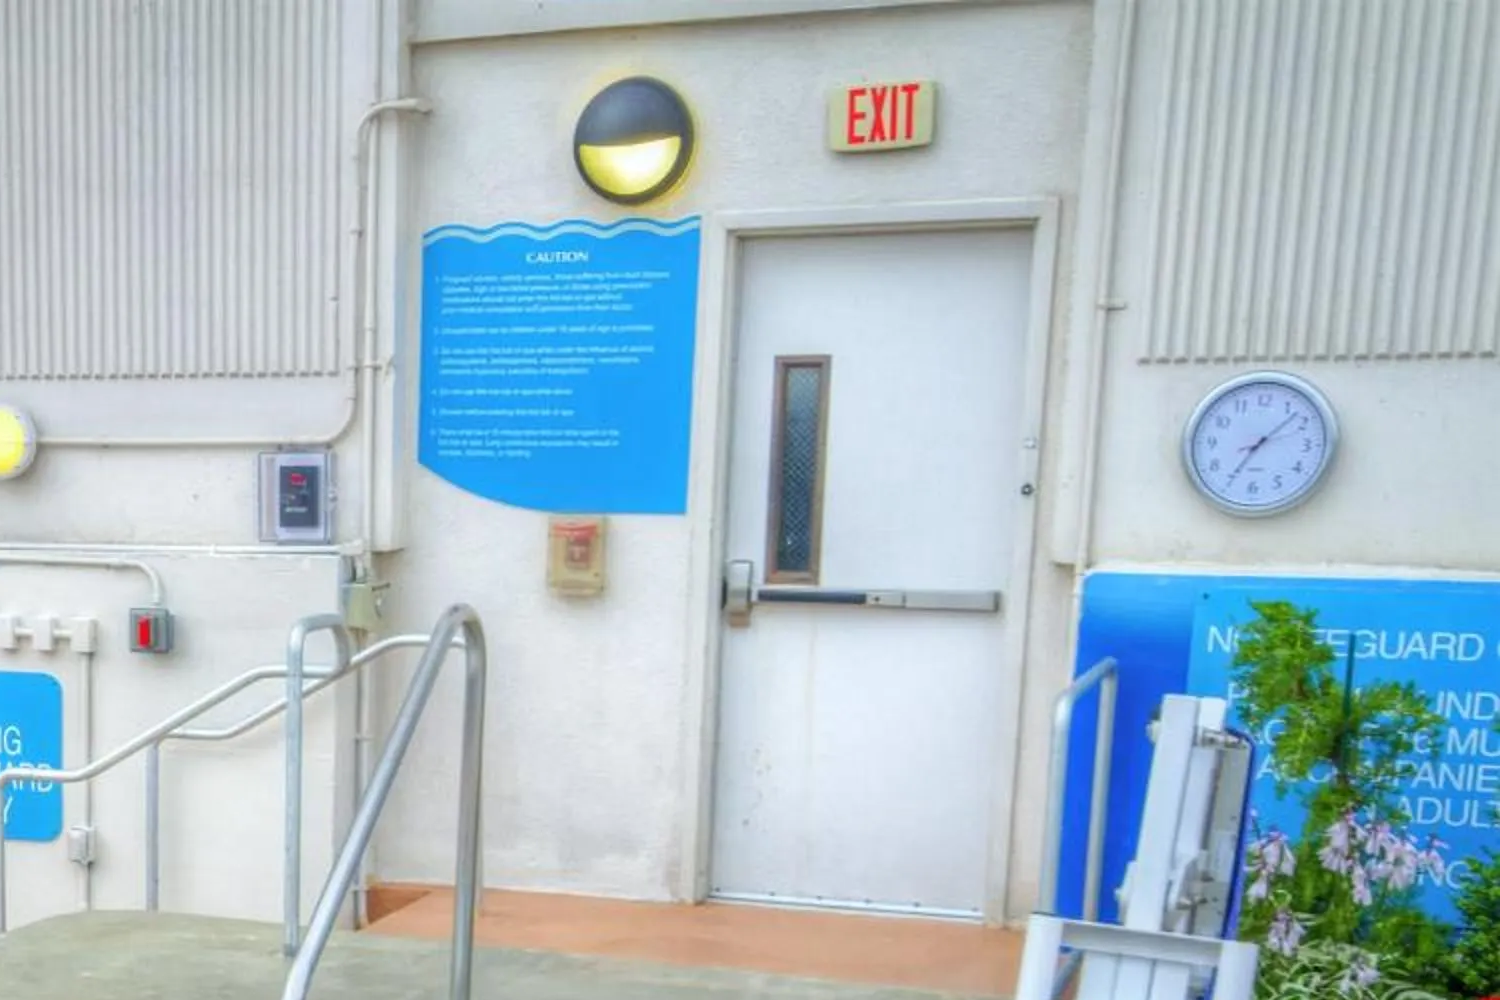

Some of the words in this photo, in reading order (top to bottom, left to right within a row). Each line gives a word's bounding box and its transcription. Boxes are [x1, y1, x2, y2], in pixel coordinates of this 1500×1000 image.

[847, 83, 920, 144] EXIT
[525, 251, 589, 264] CAUTION
[1235, 399, 1247, 414] 11
[1257, 393, 1273, 407] 12
[1297, 416, 1310, 431] 2
[1207, 436, 1218, 449] 9
[1301, 438, 1312, 453] 3
[1209, 458, 1221, 472] 8
[1291, 460, 1304, 474] 4
[1226, 473, 1237, 488] 7
[1247, 481, 1259, 494] 6
[1272, 474, 1283, 490] 5
